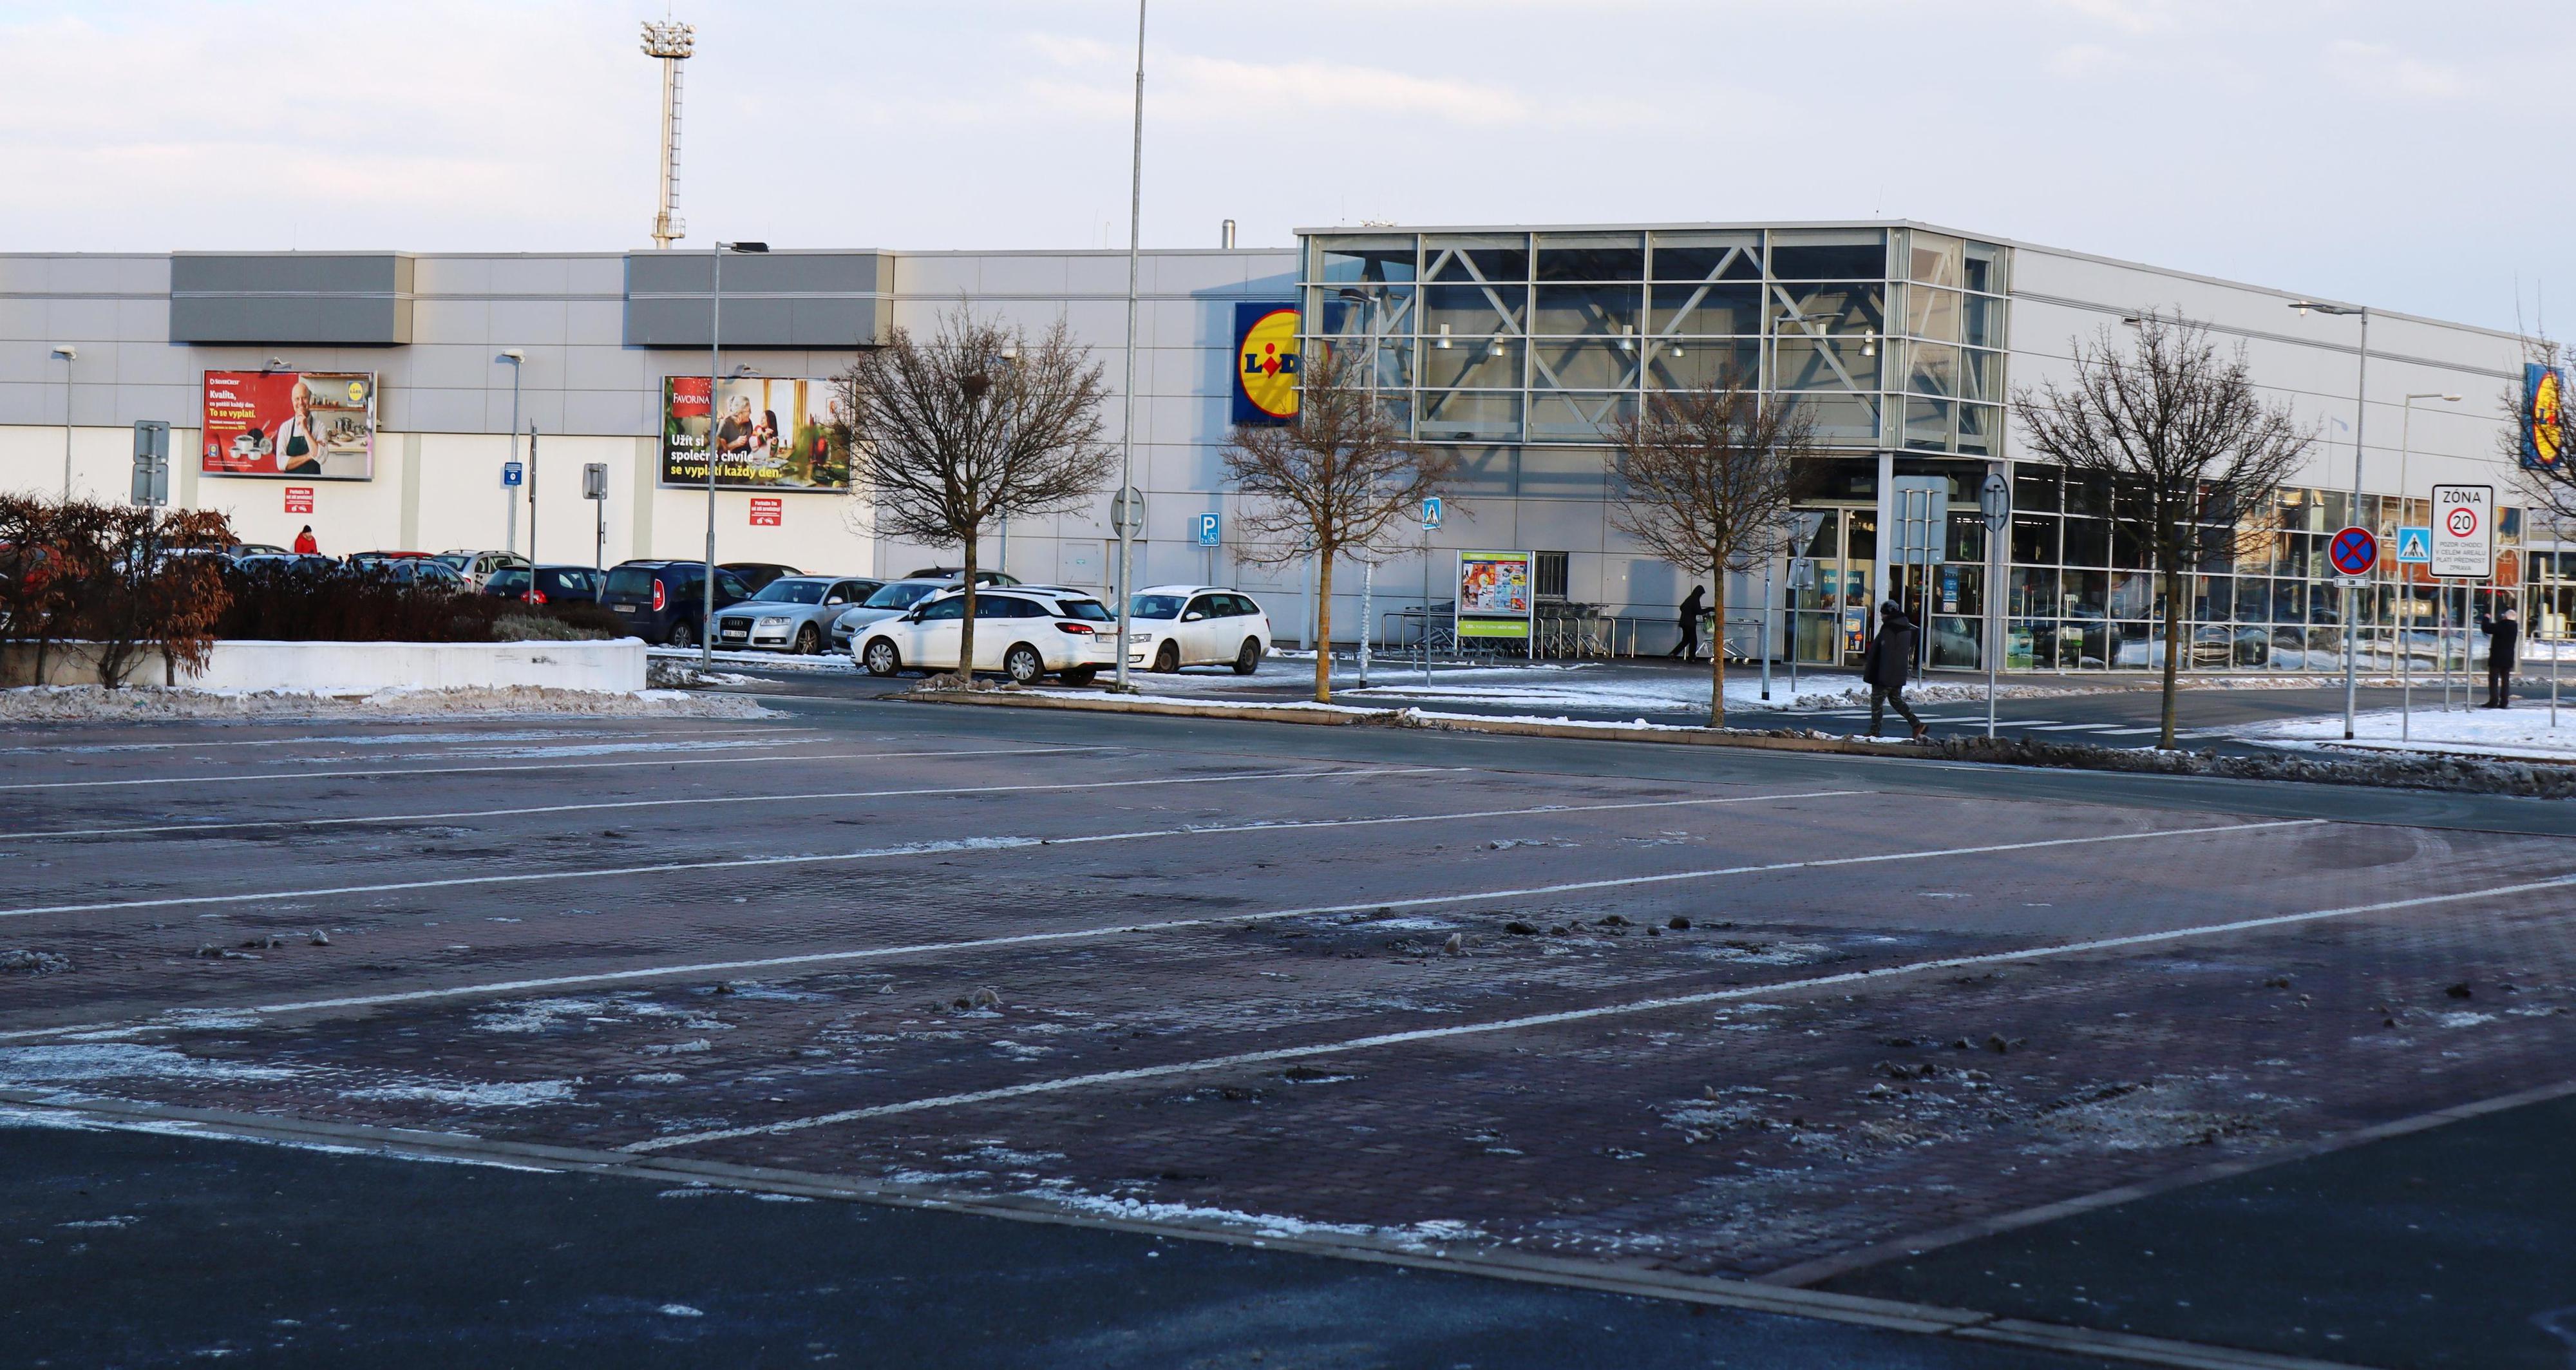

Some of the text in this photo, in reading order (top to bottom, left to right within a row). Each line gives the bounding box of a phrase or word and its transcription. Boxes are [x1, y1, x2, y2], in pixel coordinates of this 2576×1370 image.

[210, 390, 236, 400] Kvalita,
[673, 392, 710, 404] FAVORINA
[209, 408, 218, 417] To
[229, 409, 256, 419] vyplatí.
[671, 434, 705, 446] Užít si
[721, 451, 753, 462] chvíle
[670, 466, 683, 475] se
[724, 464, 756, 480] každý
[758, 466, 783, 478] den.
[2443, 488, 2481, 503] ZÓNA
[1204, 517, 1215, 536] P
[2453, 515, 2470, 529] 20
